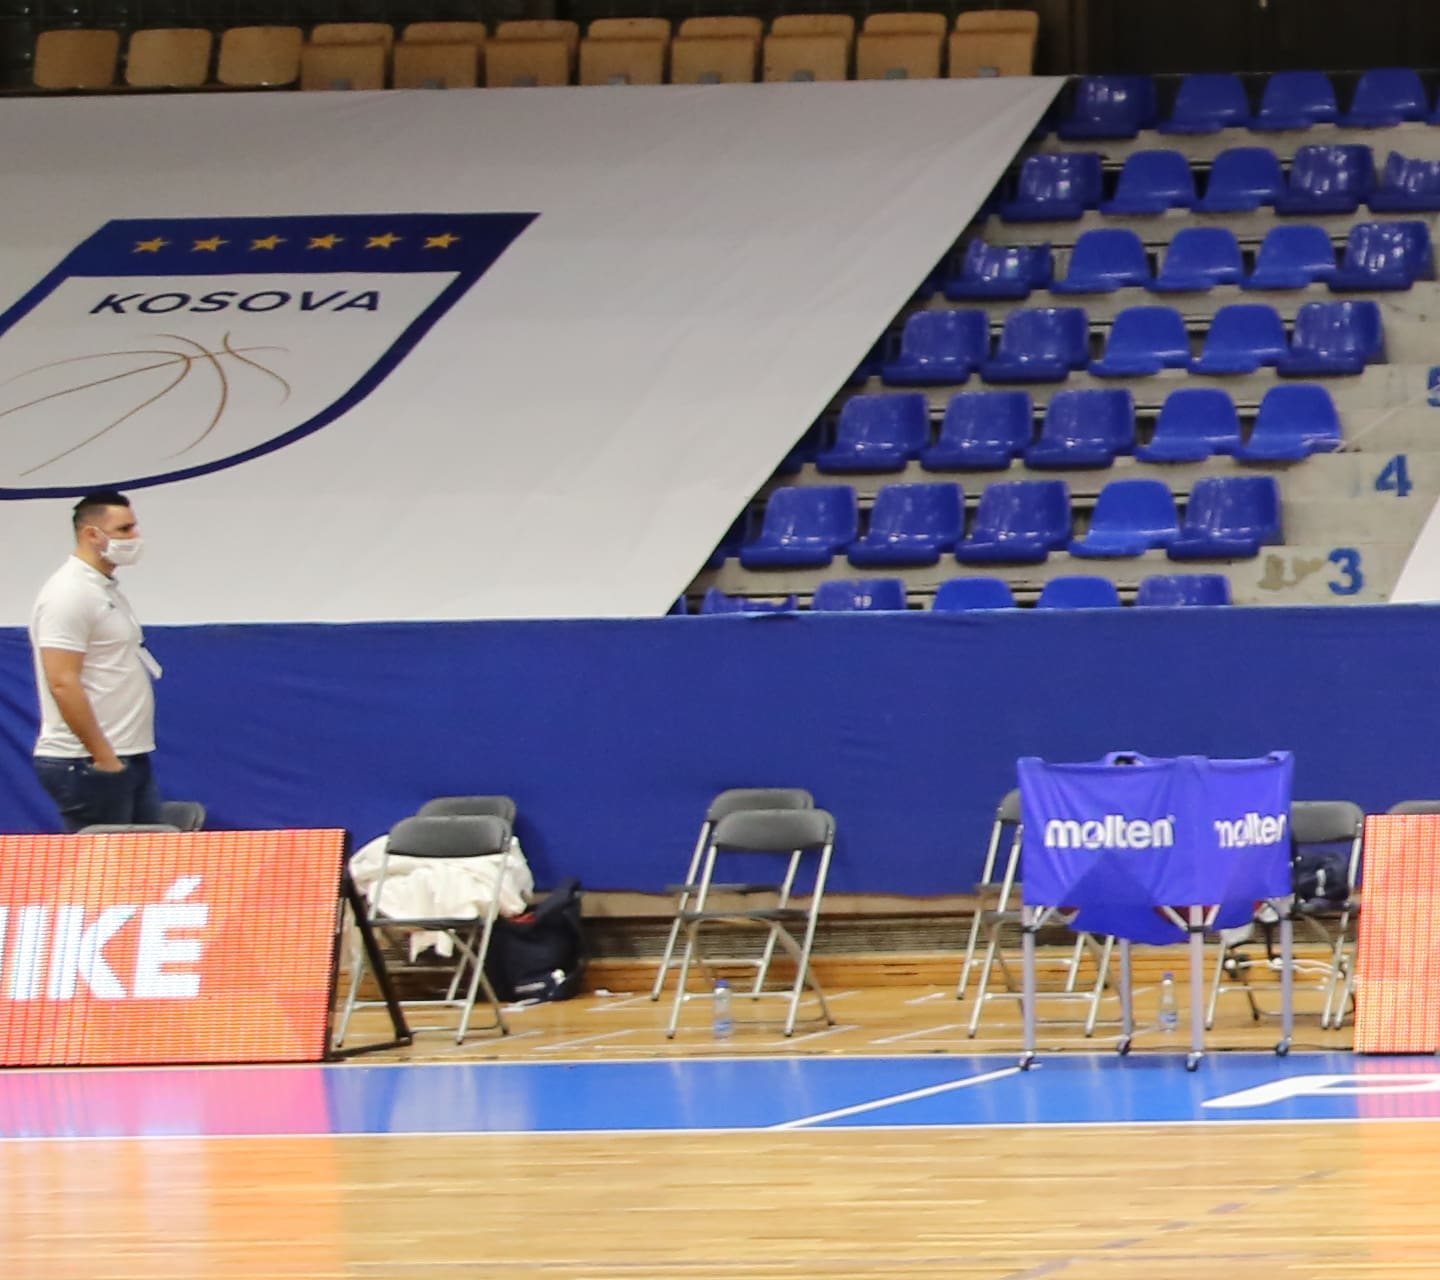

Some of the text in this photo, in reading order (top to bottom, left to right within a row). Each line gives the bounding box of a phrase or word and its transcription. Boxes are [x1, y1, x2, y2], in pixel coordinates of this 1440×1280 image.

[89, 291, 380, 314] KOSOVA
[1374, 454, 1414, 497] 4
[1327, 548, 1365, 596] 3
[1044, 815, 1172, 849] molten
[0, 875, 210, 1000] IKÉ
